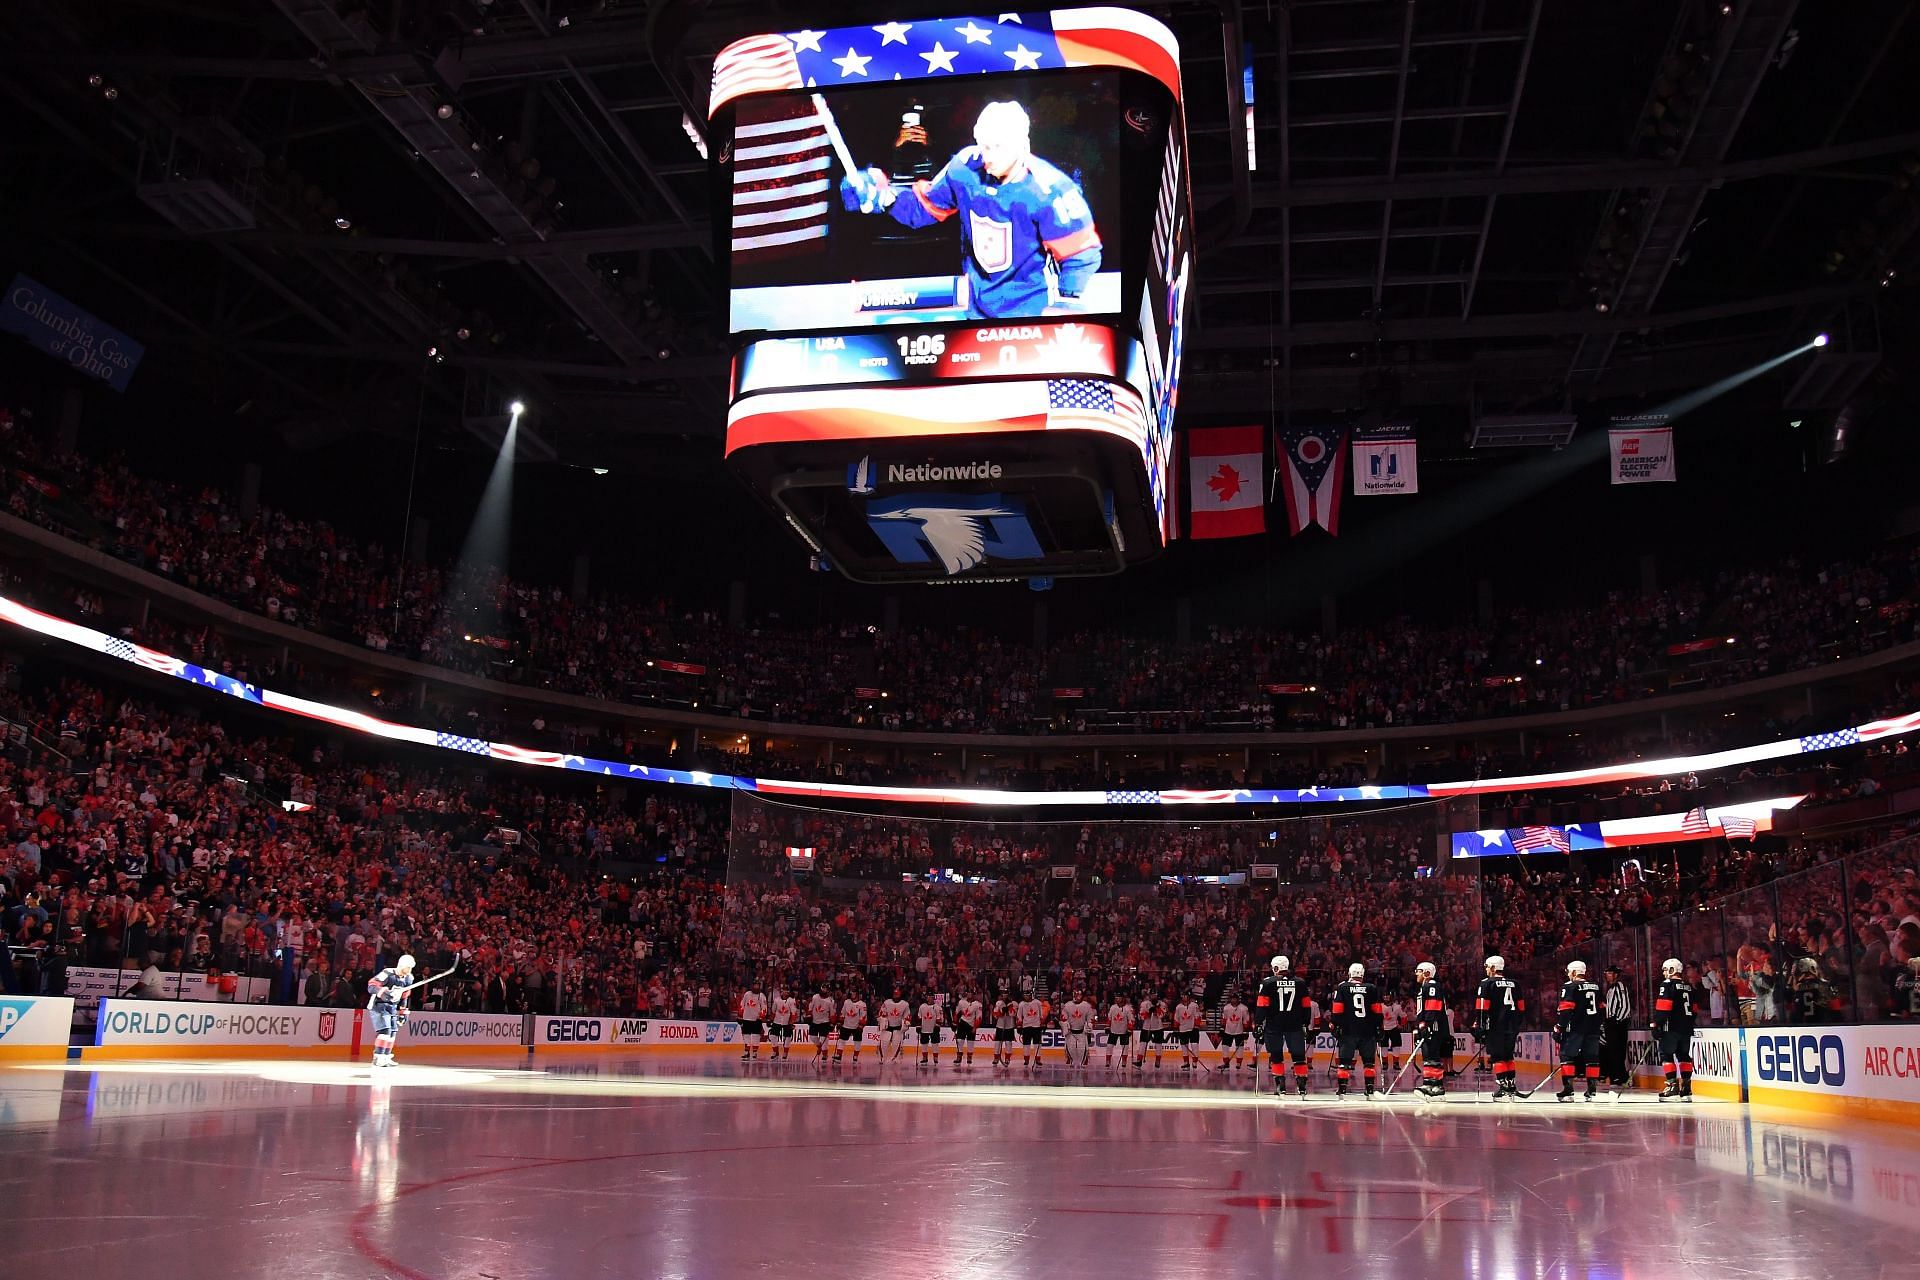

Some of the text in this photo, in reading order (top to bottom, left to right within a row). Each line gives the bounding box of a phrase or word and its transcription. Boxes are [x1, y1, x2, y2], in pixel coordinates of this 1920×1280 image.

[859, 292, 918, 307] UBINSKY
[13, 287, 129, 369] Columbia Gas
[976, 327, 1043, 343] CANADA
[815, 337, 846, 352] USA
[897, 335, 945, 356] 1:06
[50, 340, 113, 380] of Ohio
[888, 461, 1003, 483] Nationwide
[1365, 481, 1405, 489] Nationwide
[1277, 987, 1296, 1012] 17
[1428, 986, 1436, 997] 8
[1503, 987, 1516, 1011] 4
[1585, 991, 1597, 1015] 3
[1353, 993, 1366, 1018] 9
[1682, 992, 1693, 1016] 2
[175, 1013, 214, 1036] CUP
[215, 1018, 227, 1031] OF
[230, 1014, 302, 1037] HOCKEY
[409, 1020, 453, 1037] WORLD
[456, 1021, 478, 1037] CUP
[487, 1022, 522, 1038] HOCKE
[547, 1020, 601, 1042] GEICO
[619, 1020, 648, 1036] AMP
[659, 1026, 699, 1039] HONDA
[1692, 1041, 1734, 1078] CANADIAN
[1757, 1035, 1846, 1087] GEICO
[1864, 1047, 1892, 1079] AIR
